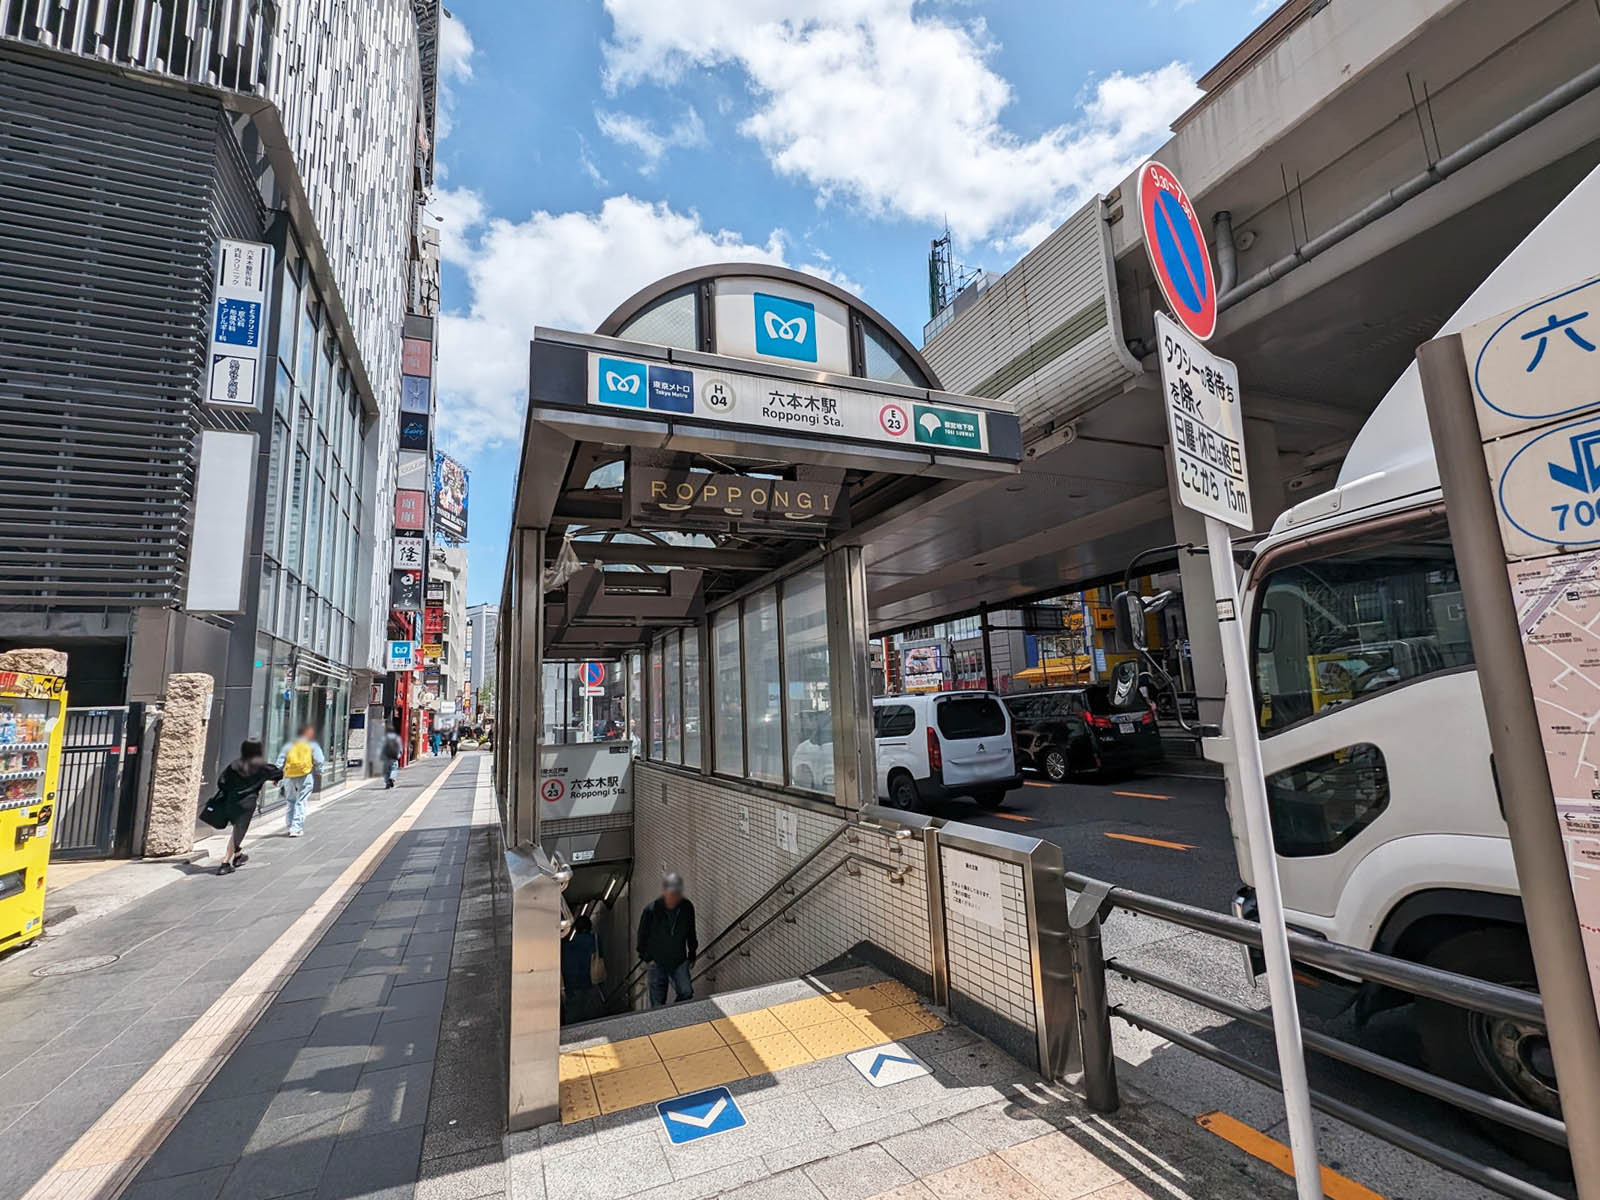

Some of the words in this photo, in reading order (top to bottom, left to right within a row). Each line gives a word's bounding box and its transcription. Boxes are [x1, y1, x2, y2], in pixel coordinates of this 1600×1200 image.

[1521, 314, 1596, 373] 六
[1164, 335, 1235, 403] タクシーの客待ち
[652, 380, 690, 393] 東京メトロ
[714, 384, 723, 395] H
[655, 388, 671, 397] Tokyo
[671, 391, 689, 399] Metro
[1170, 377, 1205, 420] を除く
[710, 395, 728, 407] 04
[768, 390, 838, 416] 六本木駅
[762, 406, 819, 426] Roppongi
[823, 415, 845, 428] Sta.
[891, 409, 897, 419] E
[887, 418, 901, 430] 23
[944, 420, 975, 432] 都営地下鉄
[1173, 412, 1243, 476] 日曜・休日は終日
[1180, 457, 1219, 501] ここから
[1224, 479, 1248, 514] 15m
[651, 480, 830, 511] ROPPONGI
[570, 776, 619, 790] 六本木駅
[546, 789, 559, 798] 23
[570, 789, 610, 799] Roppongi
